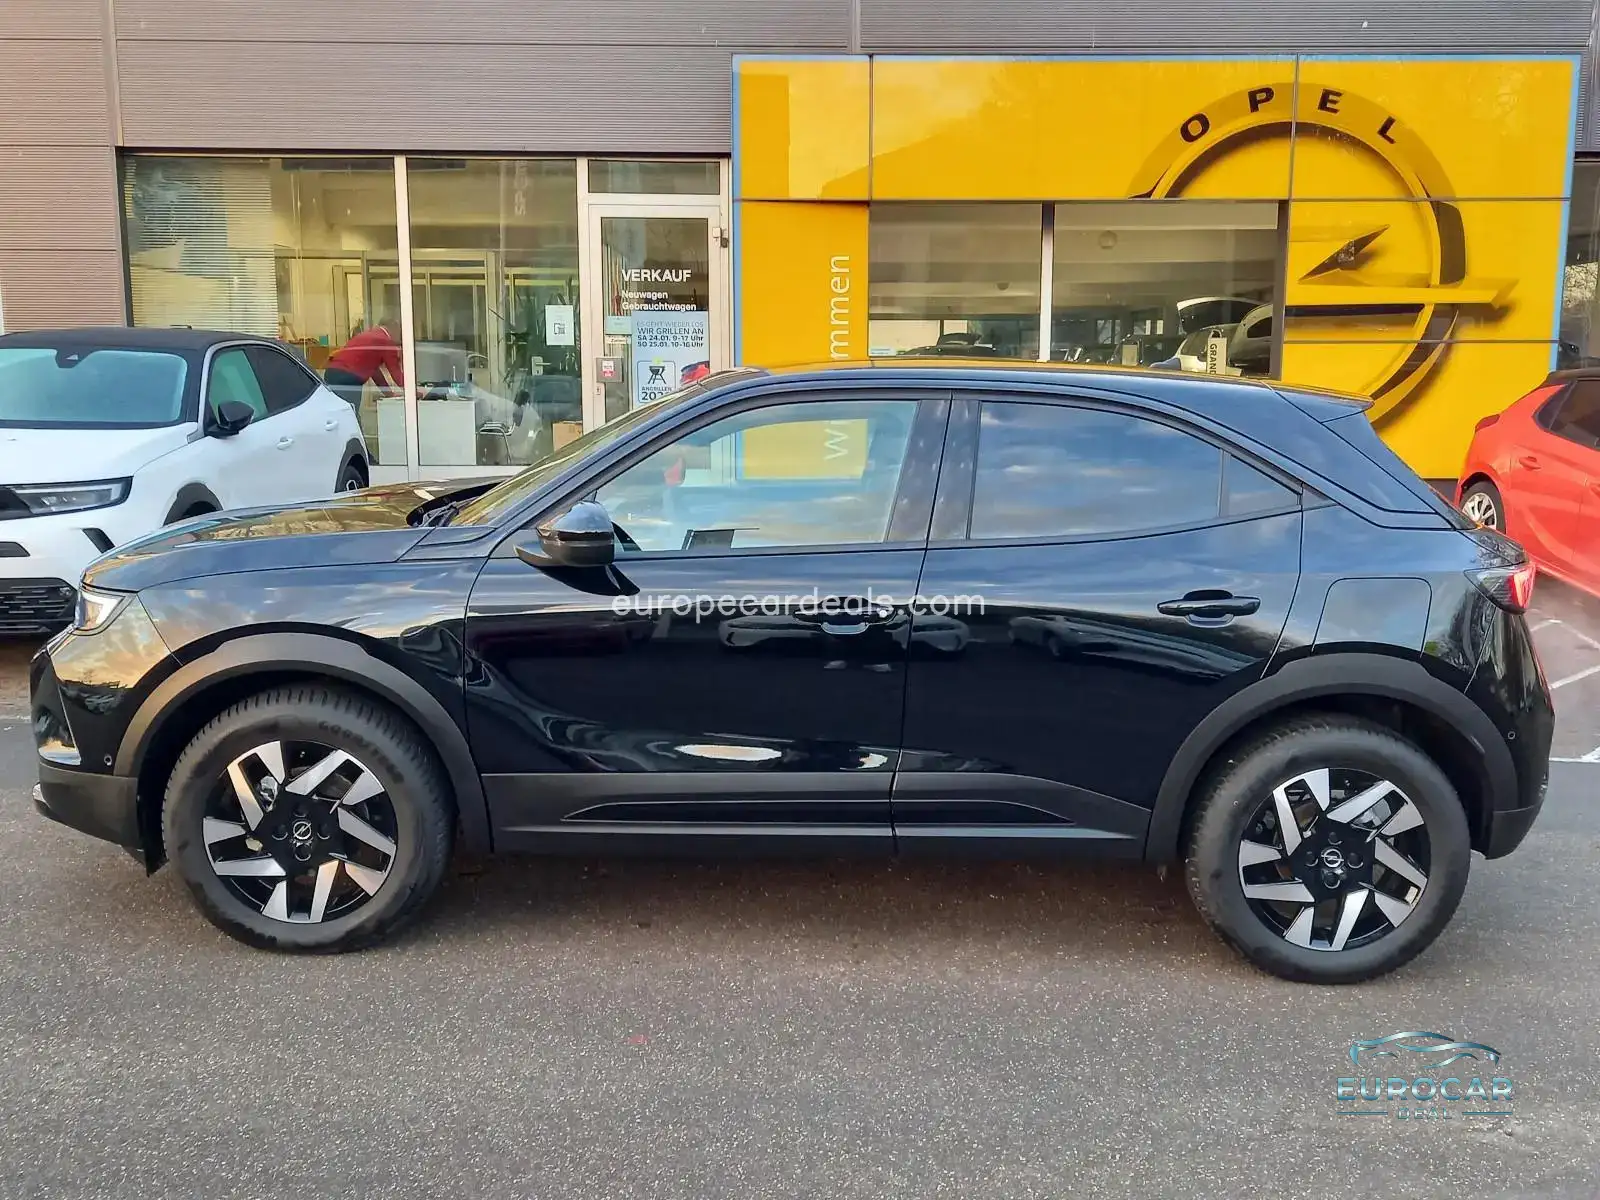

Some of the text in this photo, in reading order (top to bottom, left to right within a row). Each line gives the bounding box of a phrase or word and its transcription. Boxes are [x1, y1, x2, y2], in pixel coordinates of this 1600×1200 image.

[1179, 86, 1397, 145] OPEL
[621, 268, 692, 282] VERKAUF
[621, 290, 669, 300] Neuwagen
[621, 301, 697, 313] Gebrauchtwagen
[637, 327, 704, 335] WIR GRILLEN AN
[641, 391, 670, 401] 20
